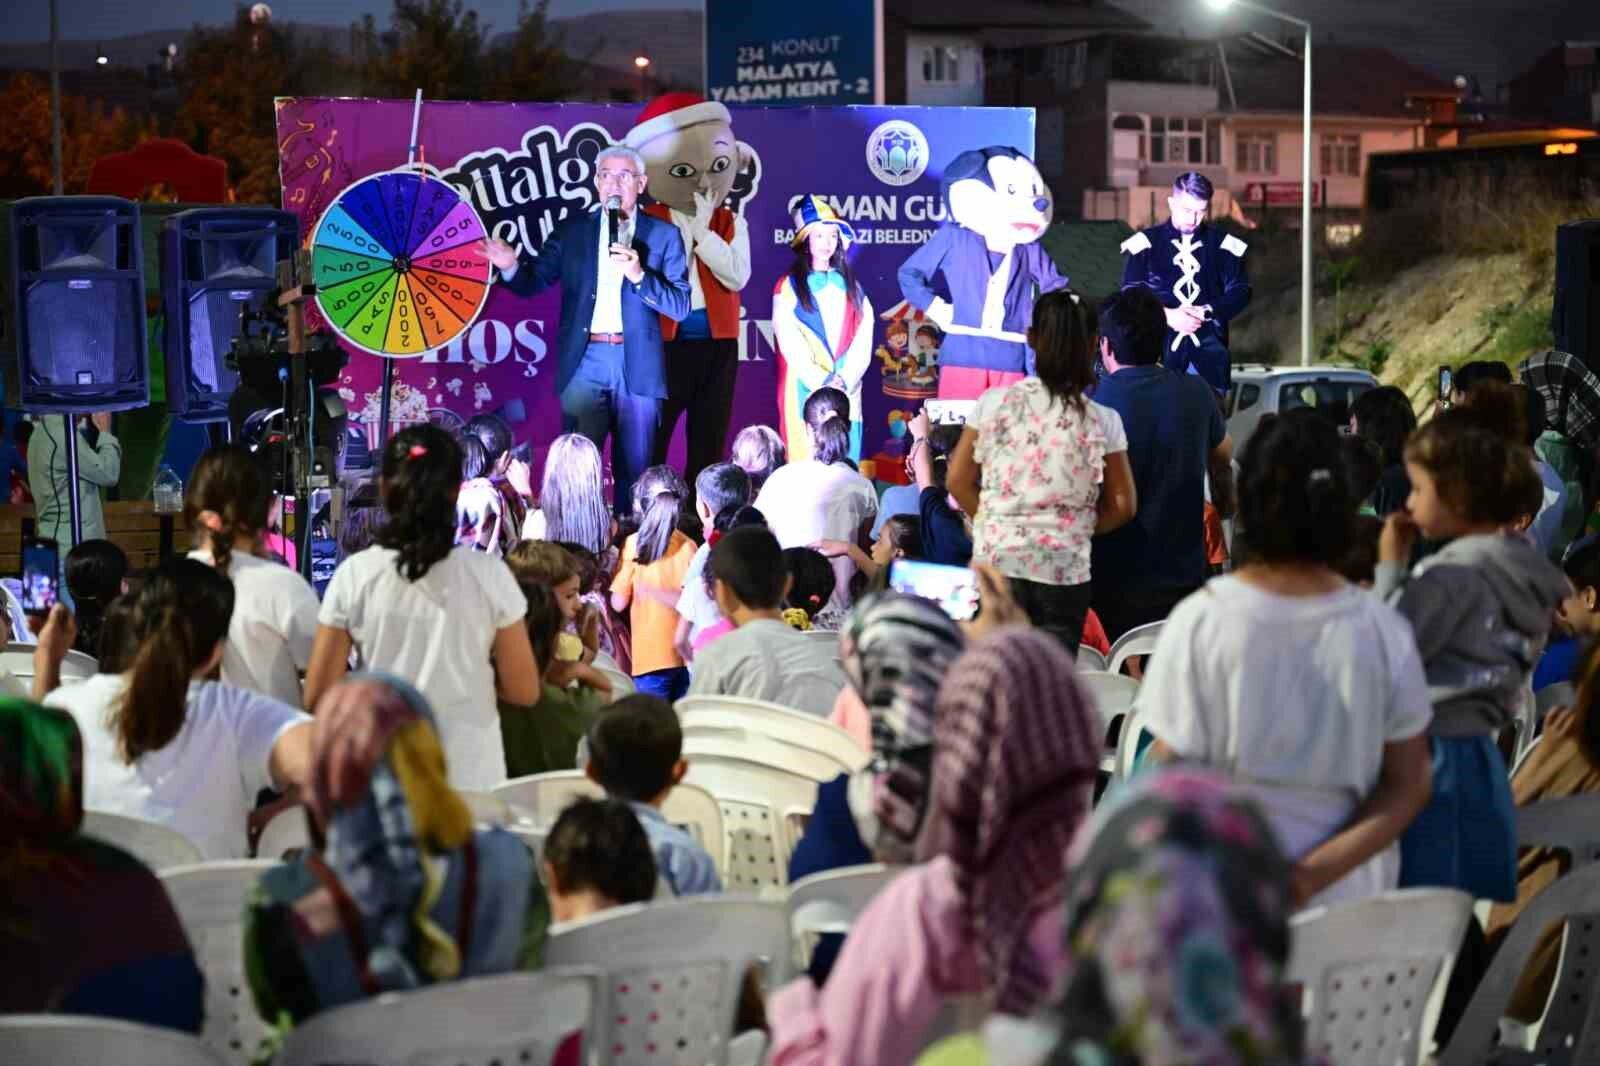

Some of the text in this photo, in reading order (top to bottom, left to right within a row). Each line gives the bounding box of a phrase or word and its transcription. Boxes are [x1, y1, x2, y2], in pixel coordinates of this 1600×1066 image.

[737, 35, 841, 64] 234 KONUT
[736, 61, 837, 82] MALATYA
[711, 83, 782, 103] YAŞAM
[786, 80, 840, 98] KENT
[855, 77, 869, 94] 2
[326, 223, 380, 254] 2500
[431, 218, 473, 247] 500
[322, 262, 371, 273] 750
[431, 258, 486, 269] 1500
[333, 281, 376, 311] 500
[425, 275, 476, 307] 1000
[361, 291, 391, 335] PAS
[398, 290, 410, 348] 2000
[415, 292, 445, 335] 750
